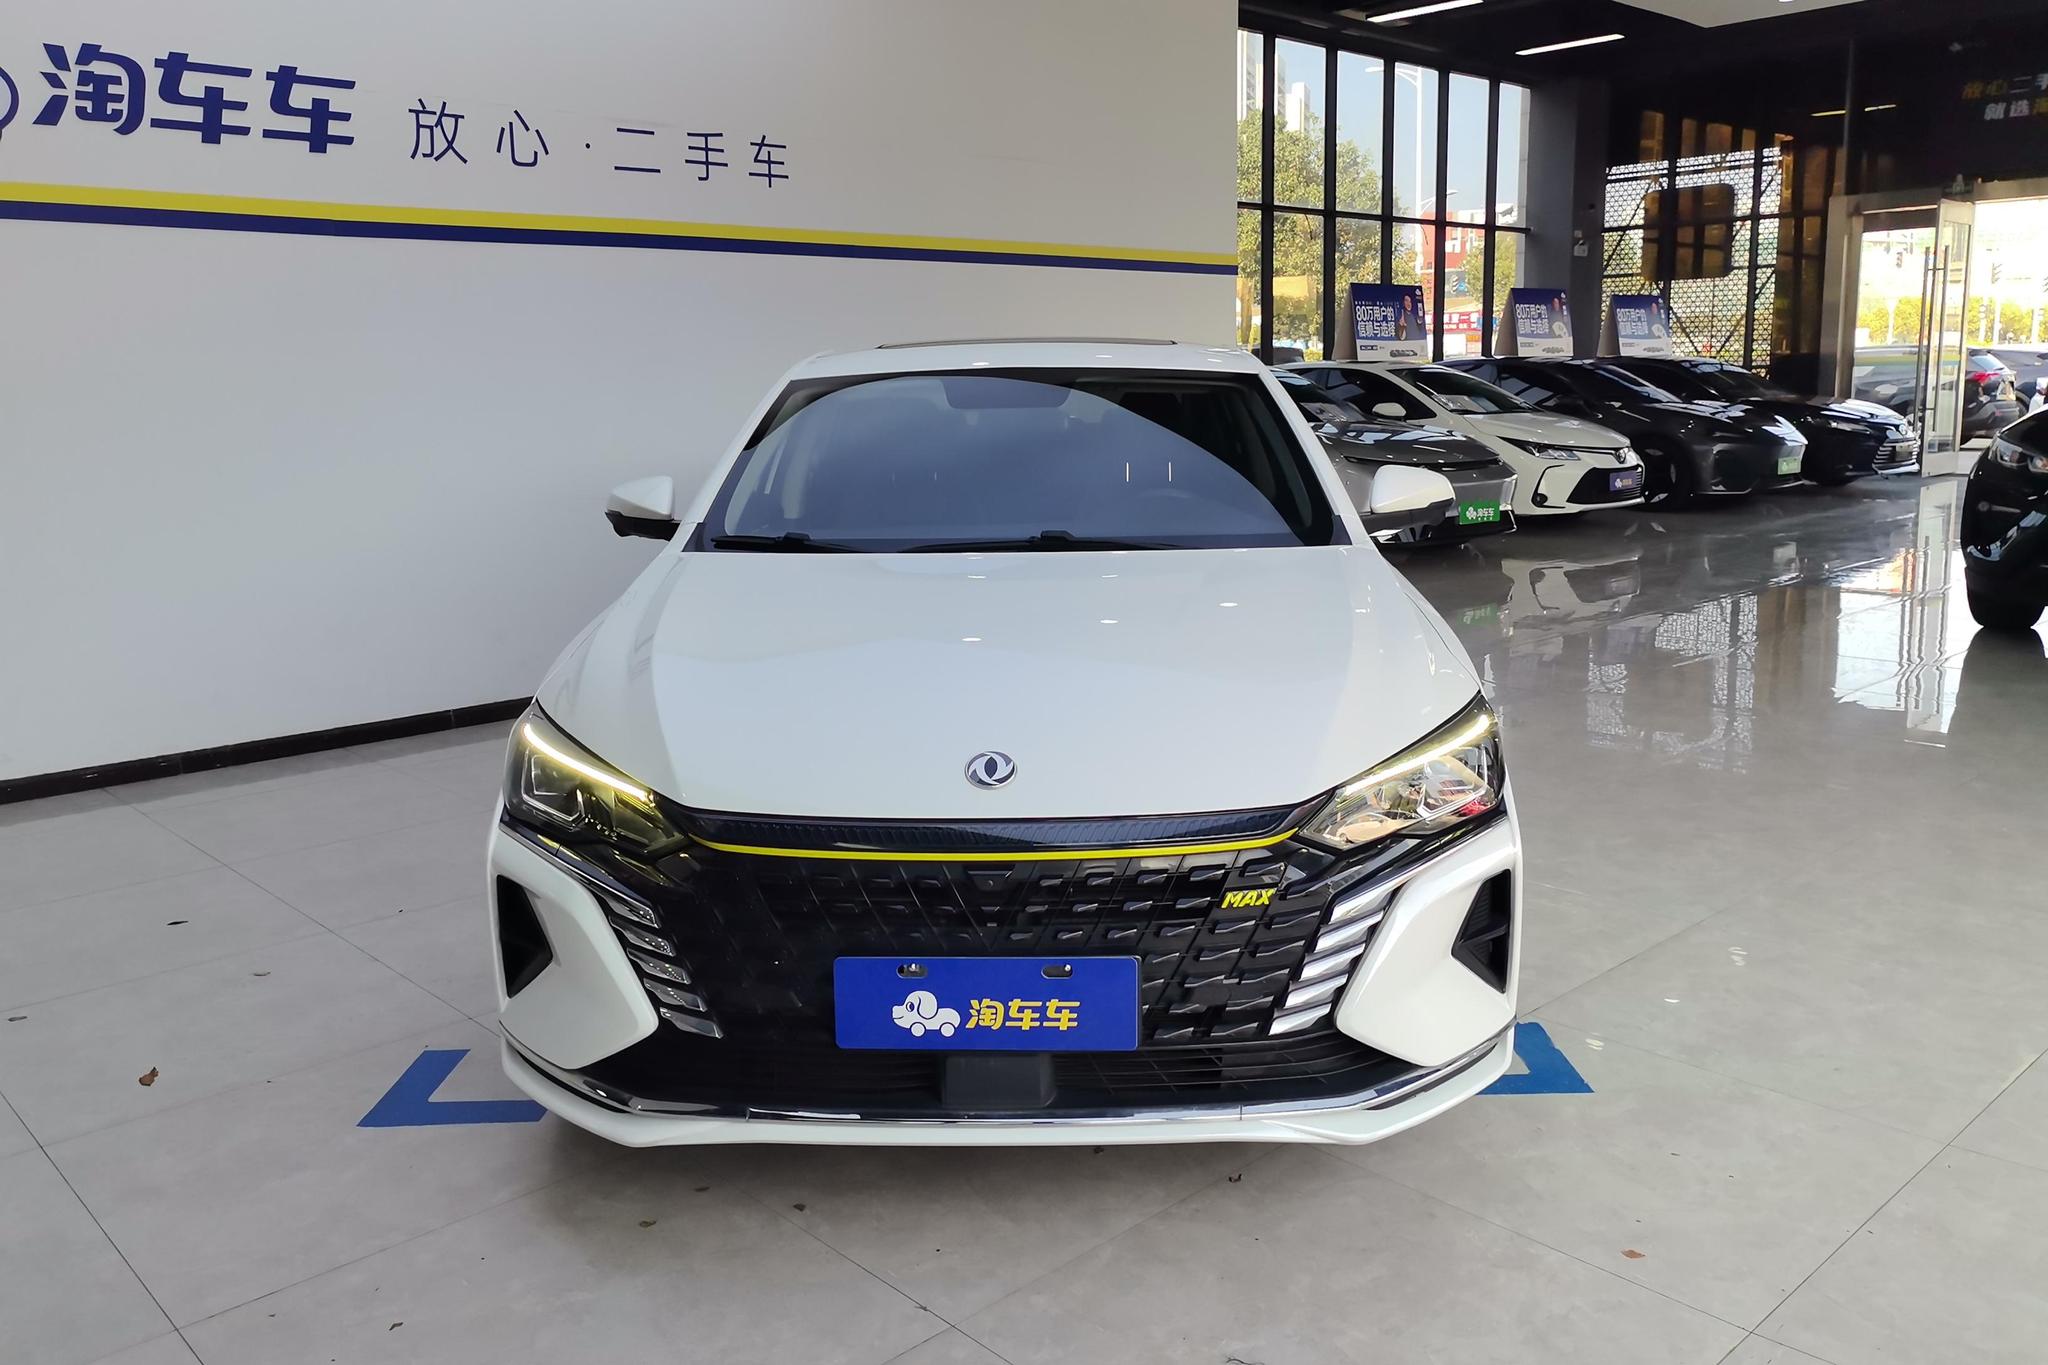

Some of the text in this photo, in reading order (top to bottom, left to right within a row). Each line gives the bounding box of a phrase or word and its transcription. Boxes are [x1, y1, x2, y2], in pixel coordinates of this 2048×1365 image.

[32, 42, 357, 154] 淘车车
[1355, 305, 1395, 321] 80万用户的
[1357, 320, 1396, 337] 信赖与选择
[1221, 888, 1277, 909] MAX
[965, 998, 1081, 1031] 淘车车
